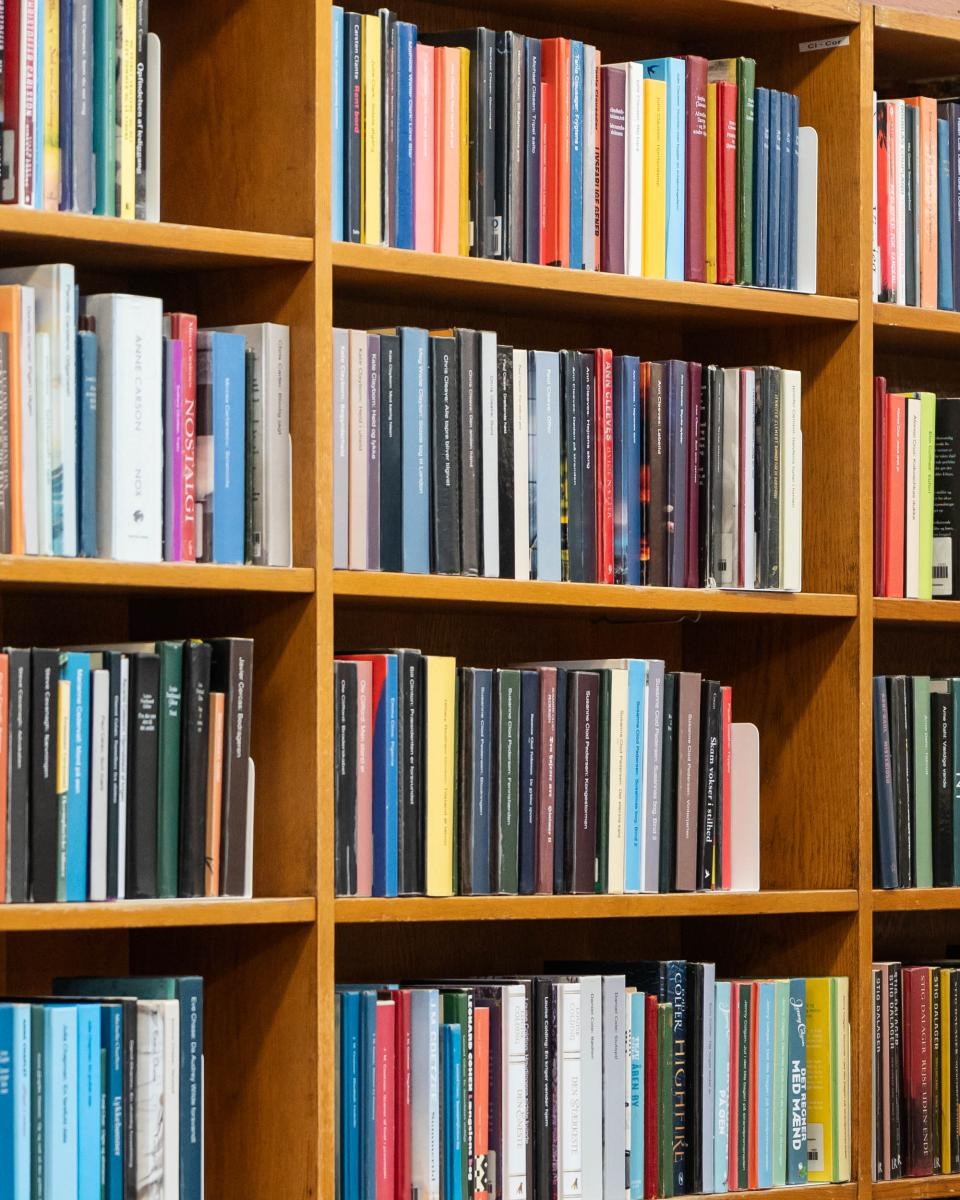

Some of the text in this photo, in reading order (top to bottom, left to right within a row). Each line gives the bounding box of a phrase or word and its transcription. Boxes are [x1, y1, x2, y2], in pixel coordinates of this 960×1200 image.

[185, 398, 195, 524] NOSTALGI
[707, 767, 715, 800] vokser
[705, 809, 713, 843] stilhed
[674, 972, 682, 1033] COLFER
[544, 1050, 549, 1060] En
[632, 1063, 642, 1108] ÅBEN BY
[673, 1039, 688, 1163] HIGHFIRE
[719, 1089, 726, 1107] PÅ
[792, 1060, 801, 1151] MED MÆND
